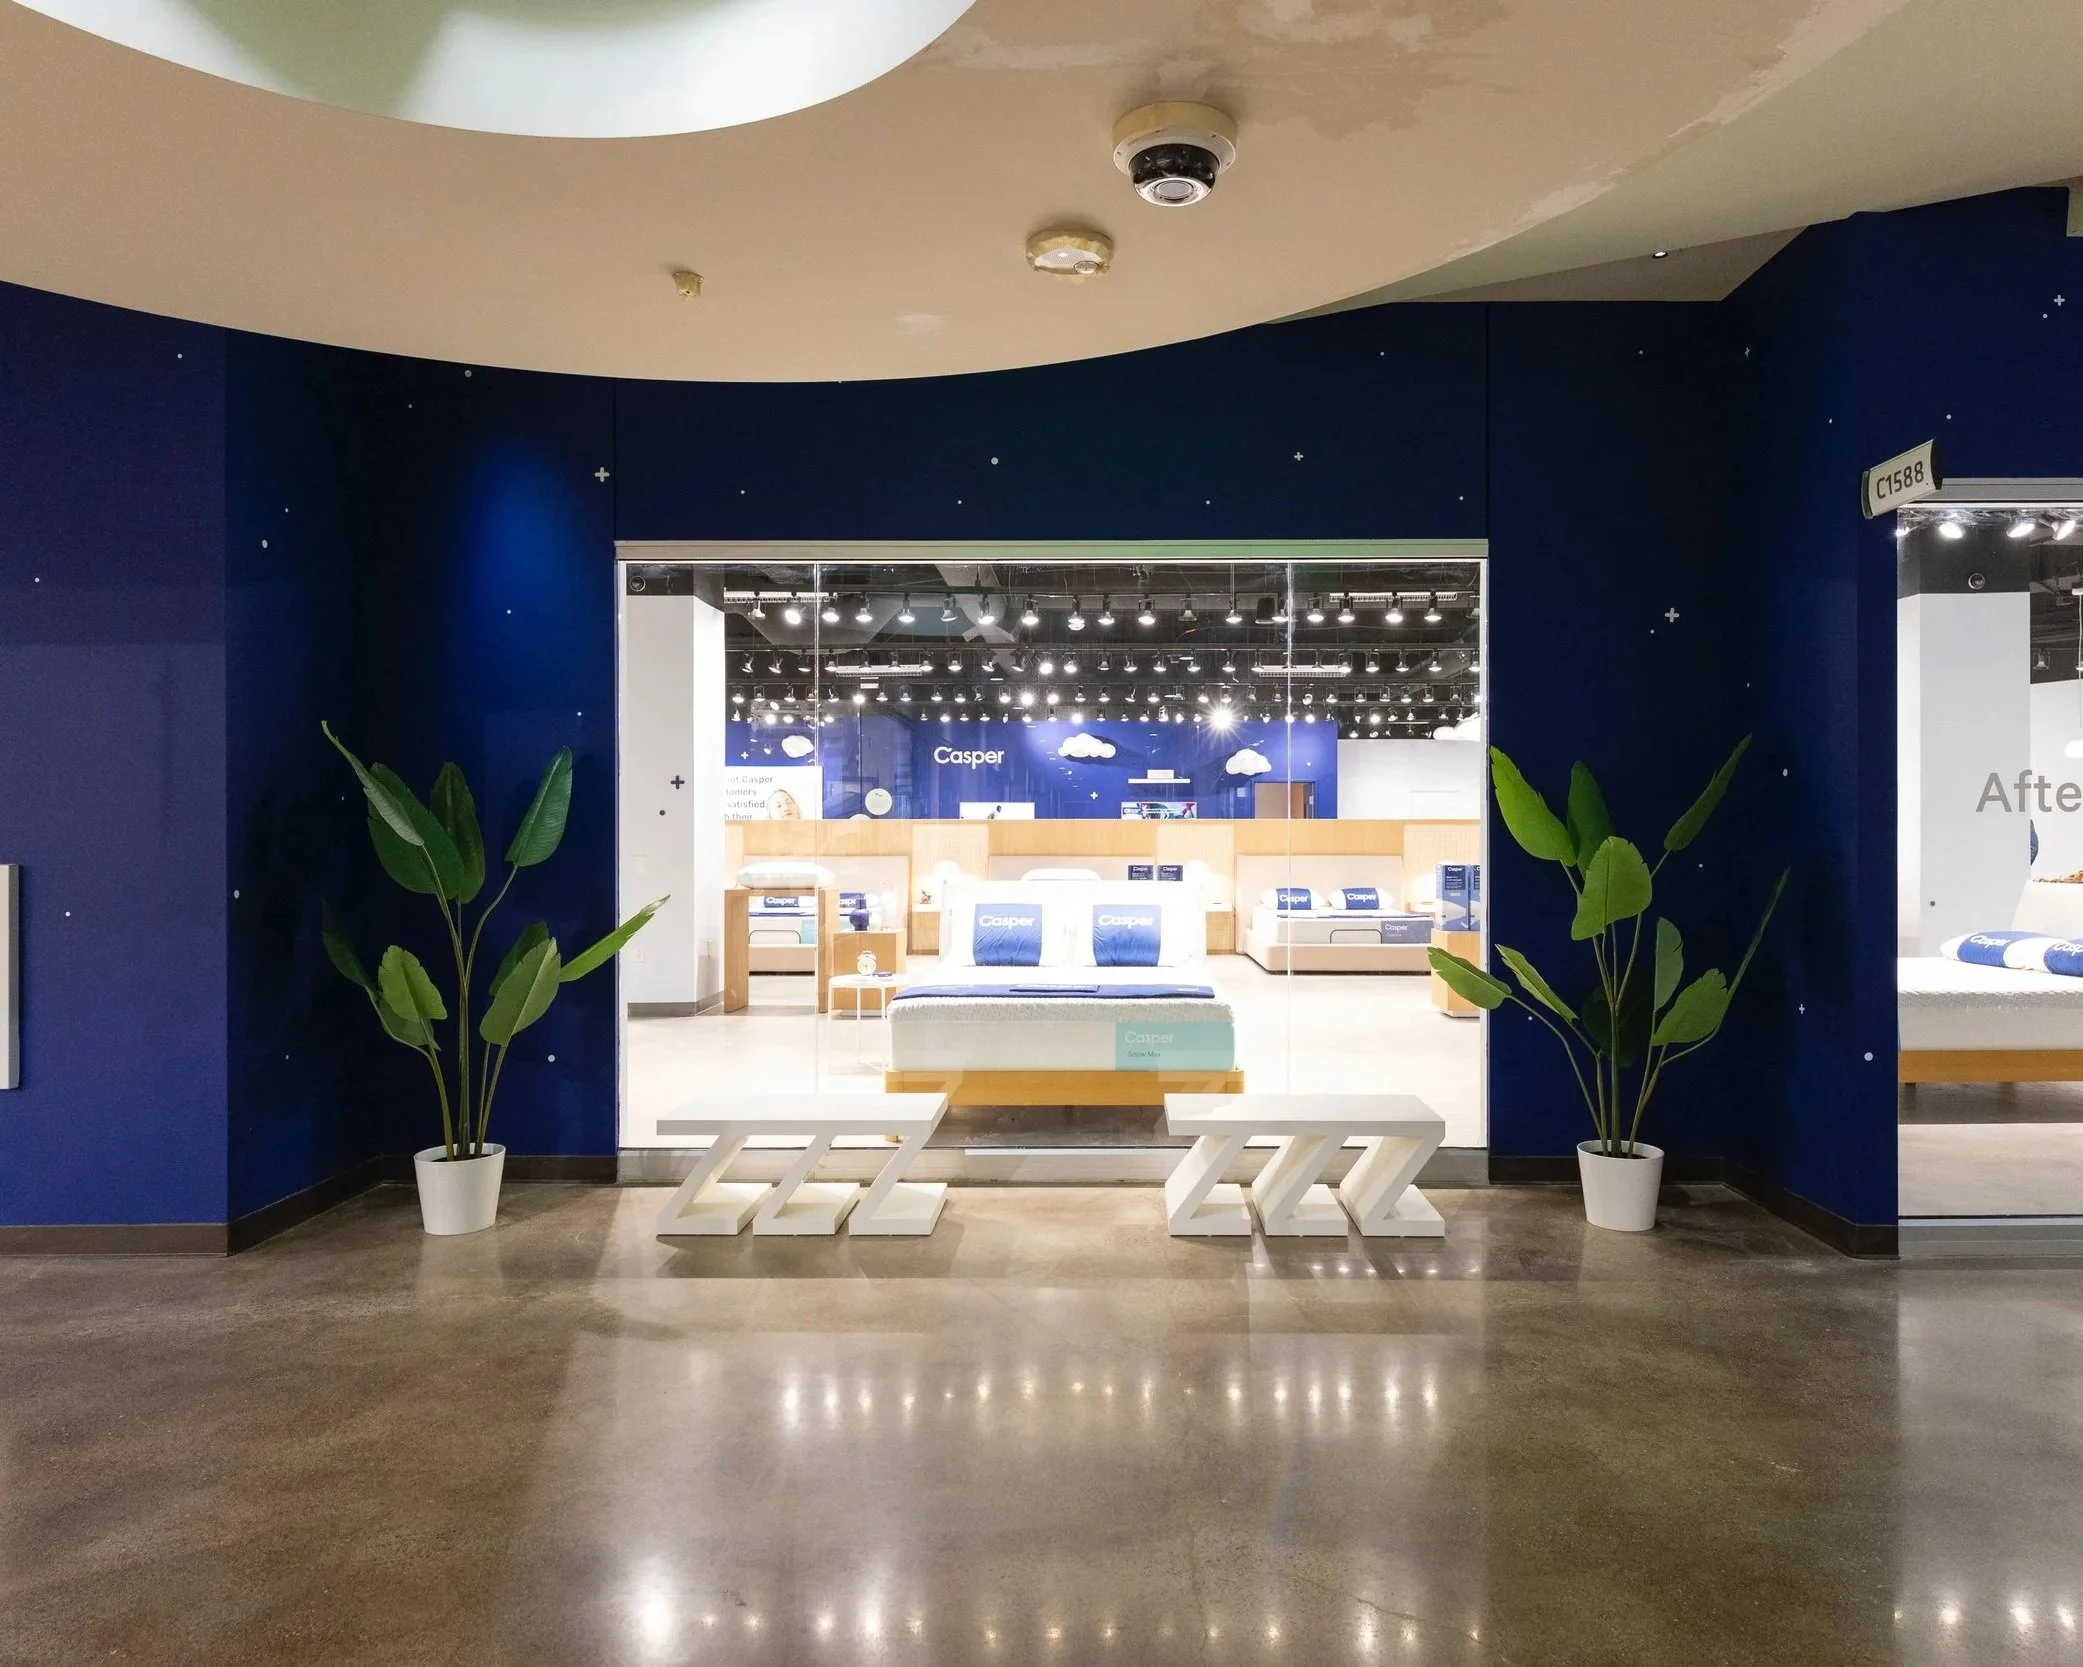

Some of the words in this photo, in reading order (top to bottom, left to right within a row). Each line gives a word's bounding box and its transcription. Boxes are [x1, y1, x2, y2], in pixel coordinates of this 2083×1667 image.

[1876, 460, 1924, 499] C1588
[933, 746, 1005, 770] Casper
[741, 775, 773, 785] Casper
[1976, 769, 2083, 813] Afte
[766, 896, 797, 907] Casper
[1279, 894, 1309, 905] Casper
[1346, 892, 1378, 904] Casper
[979, 915, 1036, 930] Casper
[1098, 914, 1155, 930] Casper
[1384, 924, 1408, 932] Casper
[1970, 935, 2010, 948] Casper
[1124, 1030, 1175, 1047] Casper
